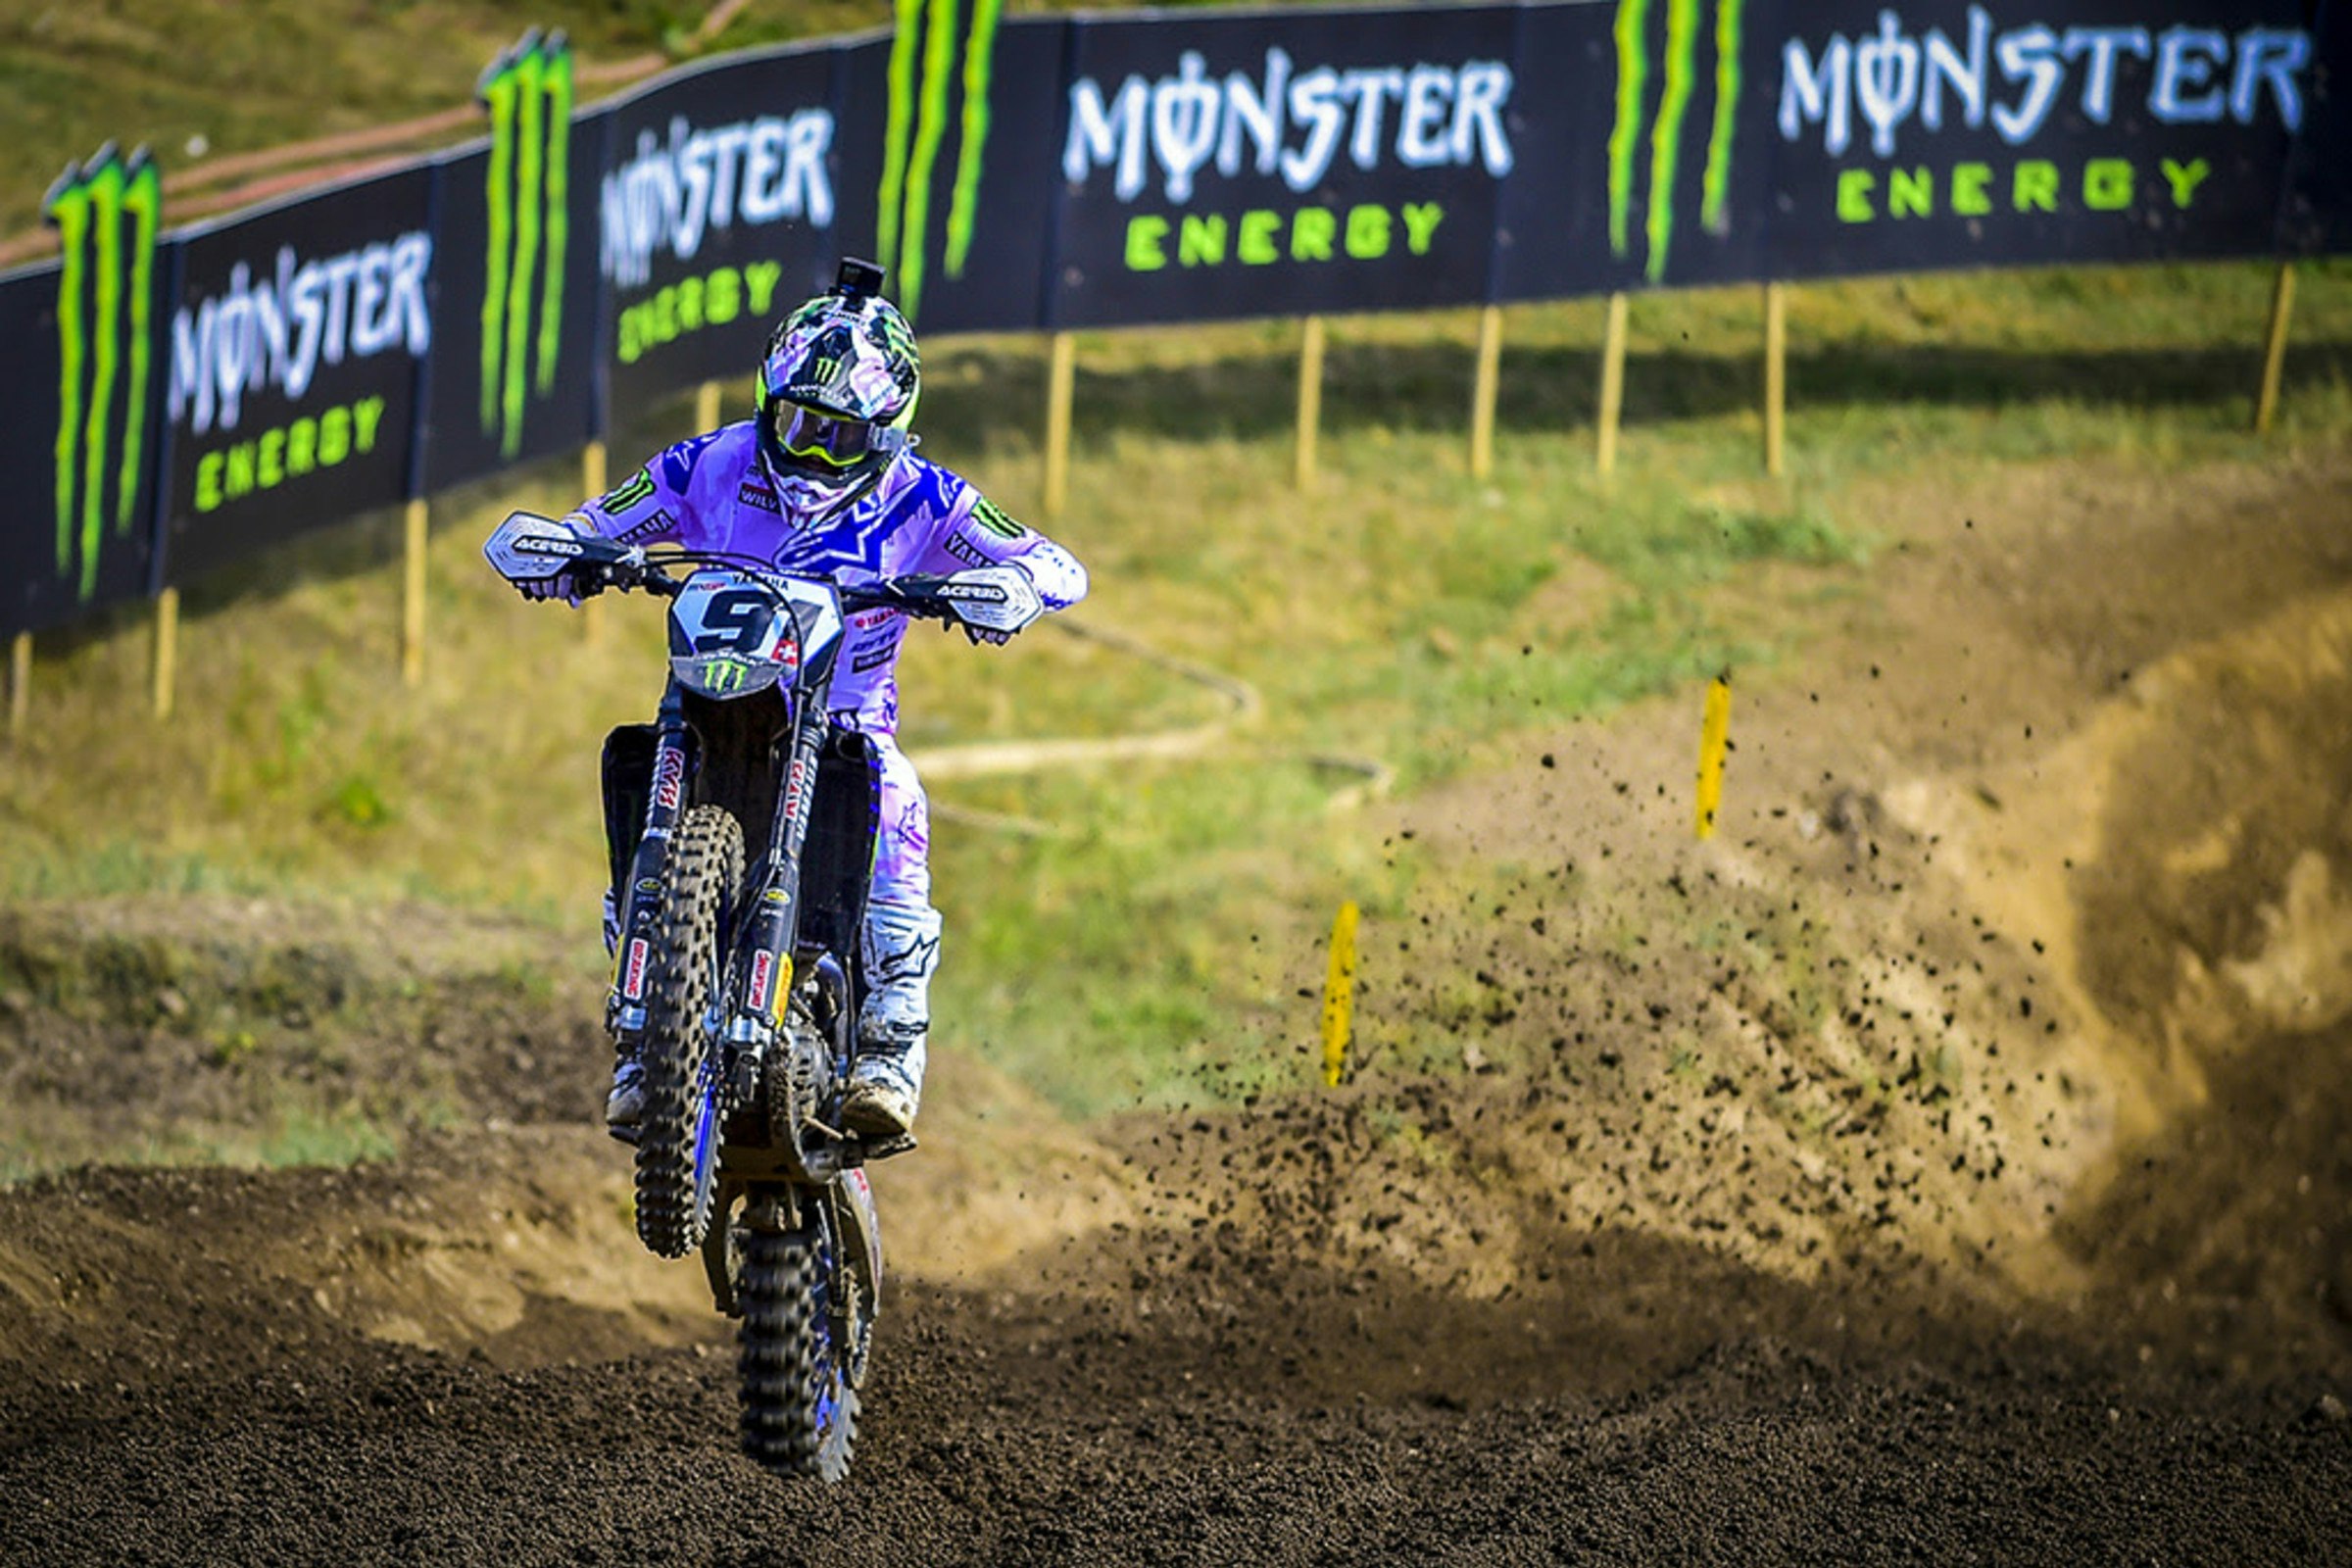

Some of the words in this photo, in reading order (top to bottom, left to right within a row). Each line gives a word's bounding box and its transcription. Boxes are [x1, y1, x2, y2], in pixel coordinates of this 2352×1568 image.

[1062, 47, 1513, 202] MONSTER
[1778, 5, 2311, 157] MONSTER
[600, 109, 834, 288] MONSTER
[1125, 202, 1445, 271] ENERGY
[1836, 158, 2210, 223] ENERGY
[168, 231, 431, 433] MONSTER
[617, 260, 781, 363] ENERGY
[195, 395, 384, 512] ENERGY
[742, 489, 778, 510] WILV
